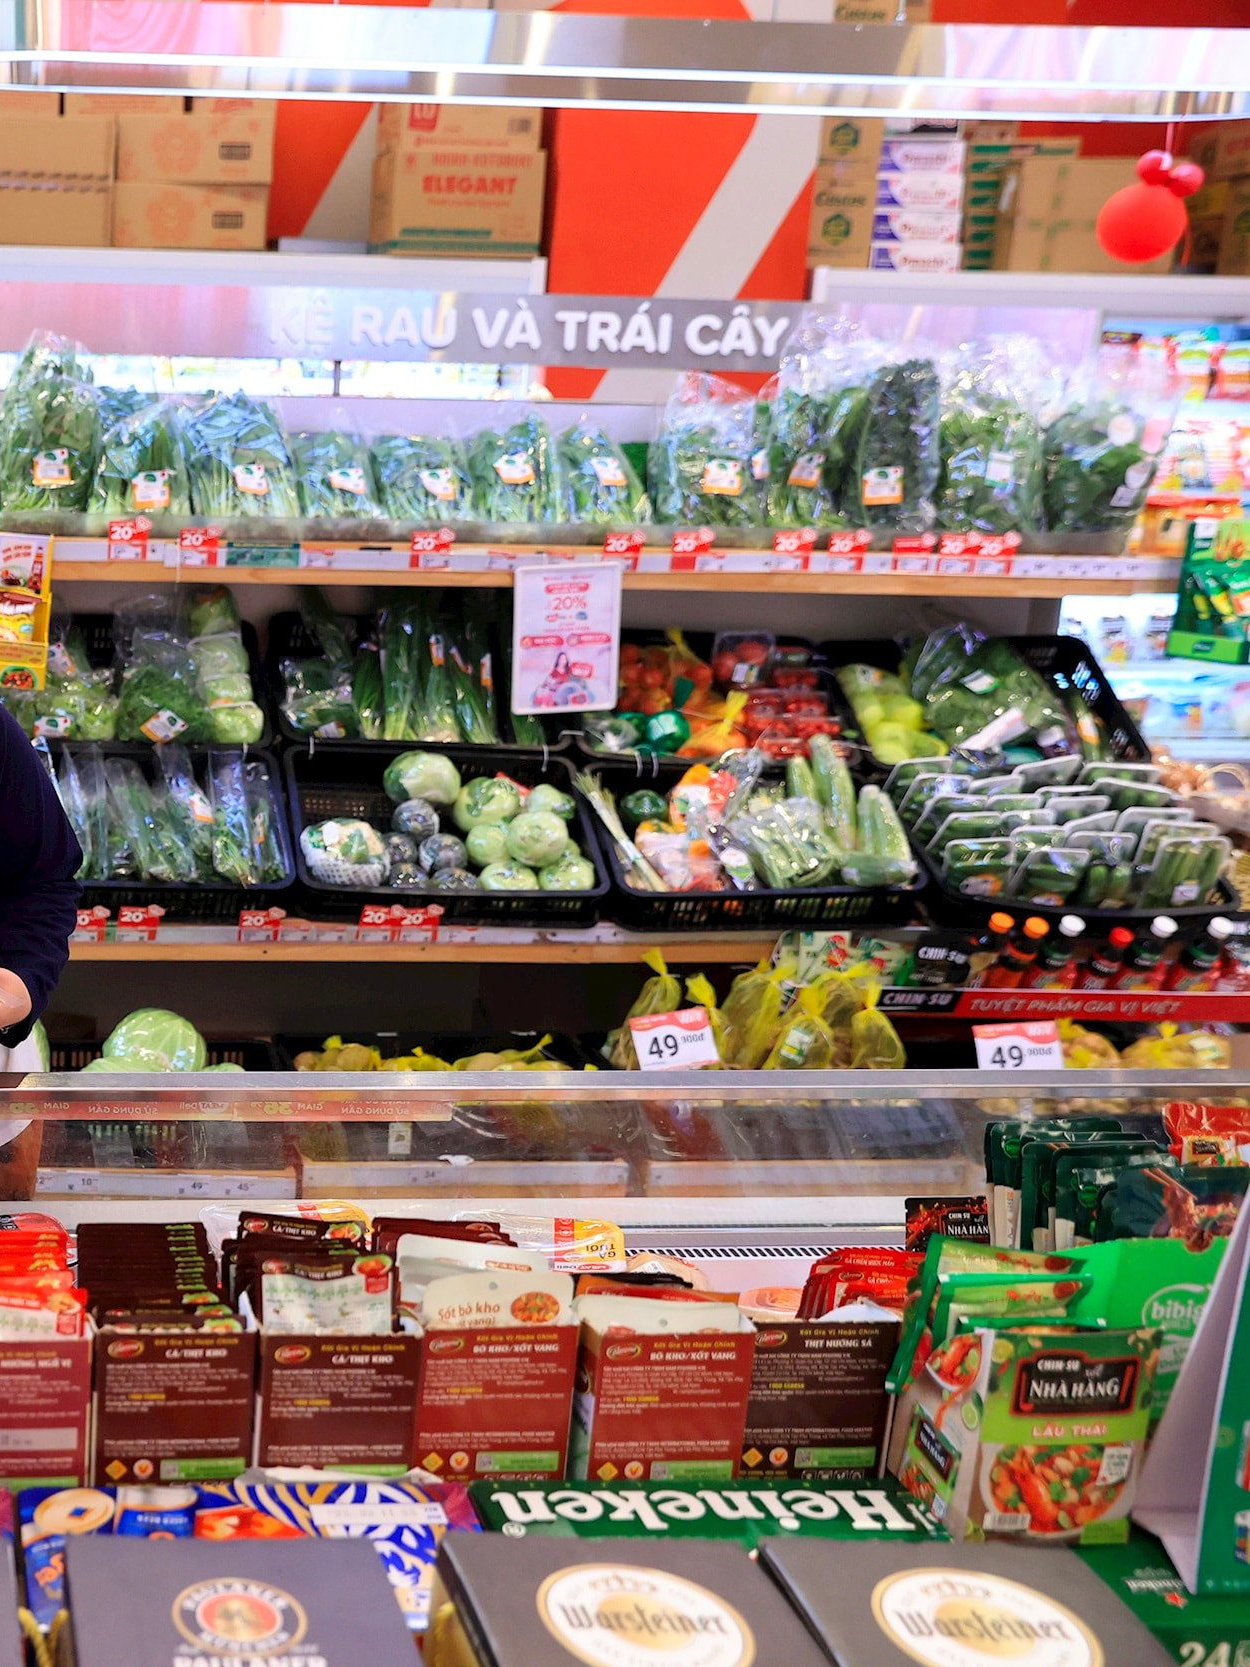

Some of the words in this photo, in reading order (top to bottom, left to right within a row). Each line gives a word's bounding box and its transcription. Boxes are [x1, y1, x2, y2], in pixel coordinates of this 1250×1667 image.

[422, 174, 518, 196] ELEGANT
[350, 305, 458, 350] RAU
[471, 297, 542, 351] VÀ
[555, 301, 673, 354] TRÁI
[684, 304, 790, 358] CÂY
[969, 1222, 990, 1235] HÀN
[476, 1302, 500, 1314] kho
[1152, 1299, 1208, 1327] bibig
[534, 1343, 559, 1352] VANG
[711, 1351, 737, 1360] VANG
[1030, 1378, 1068, 1398] NHÀ
[1071, 1376, 1119, 1398] HÀNG
[490, 1489, 917, 1531] Heineken
[560, 1601, 729, 1639] Warsteiner
[894, 1608, 1073, 1642] Warsteiner
